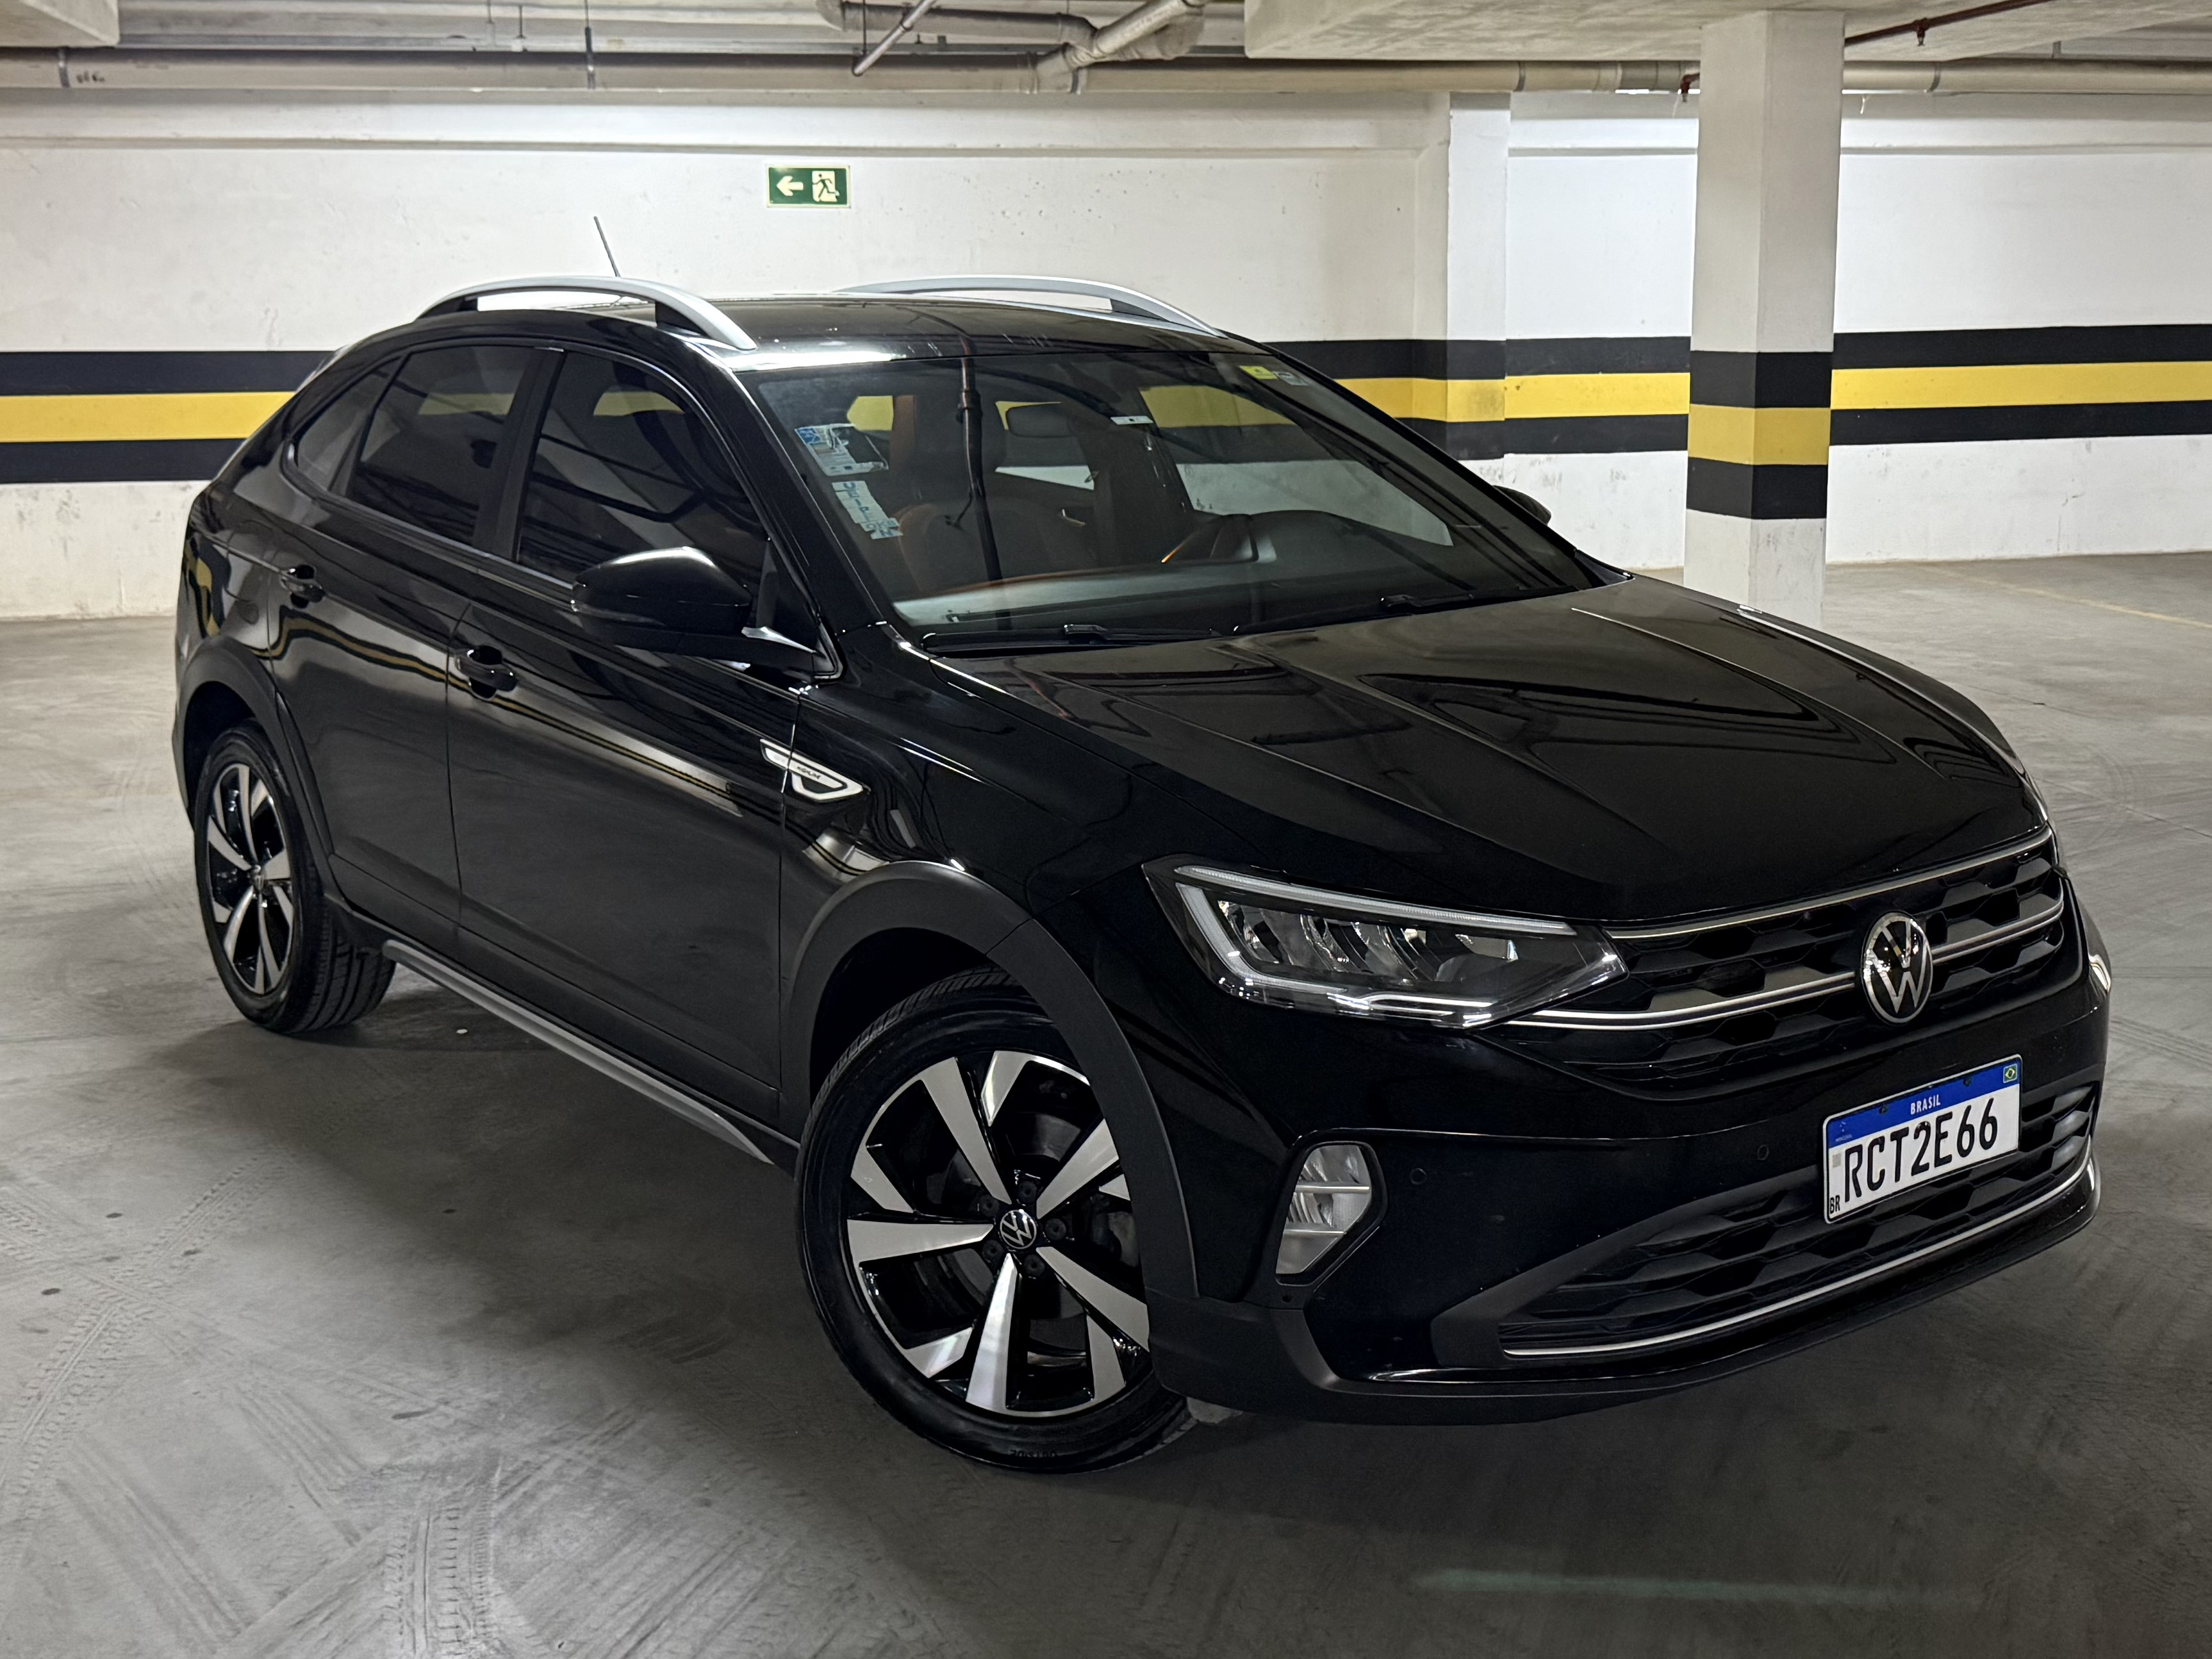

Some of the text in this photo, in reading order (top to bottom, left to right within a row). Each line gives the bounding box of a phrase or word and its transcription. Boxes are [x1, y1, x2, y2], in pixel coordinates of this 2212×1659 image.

[1867, 916, 1930, 1017] VW
[1910, 1094, 1941, 1116] BRASIL
[1844, 1097, 1998, 1203] RCT2E66
[1829, 1194, 1840, 1214] BR
[1001, 1210, 1035, 1248] VW
